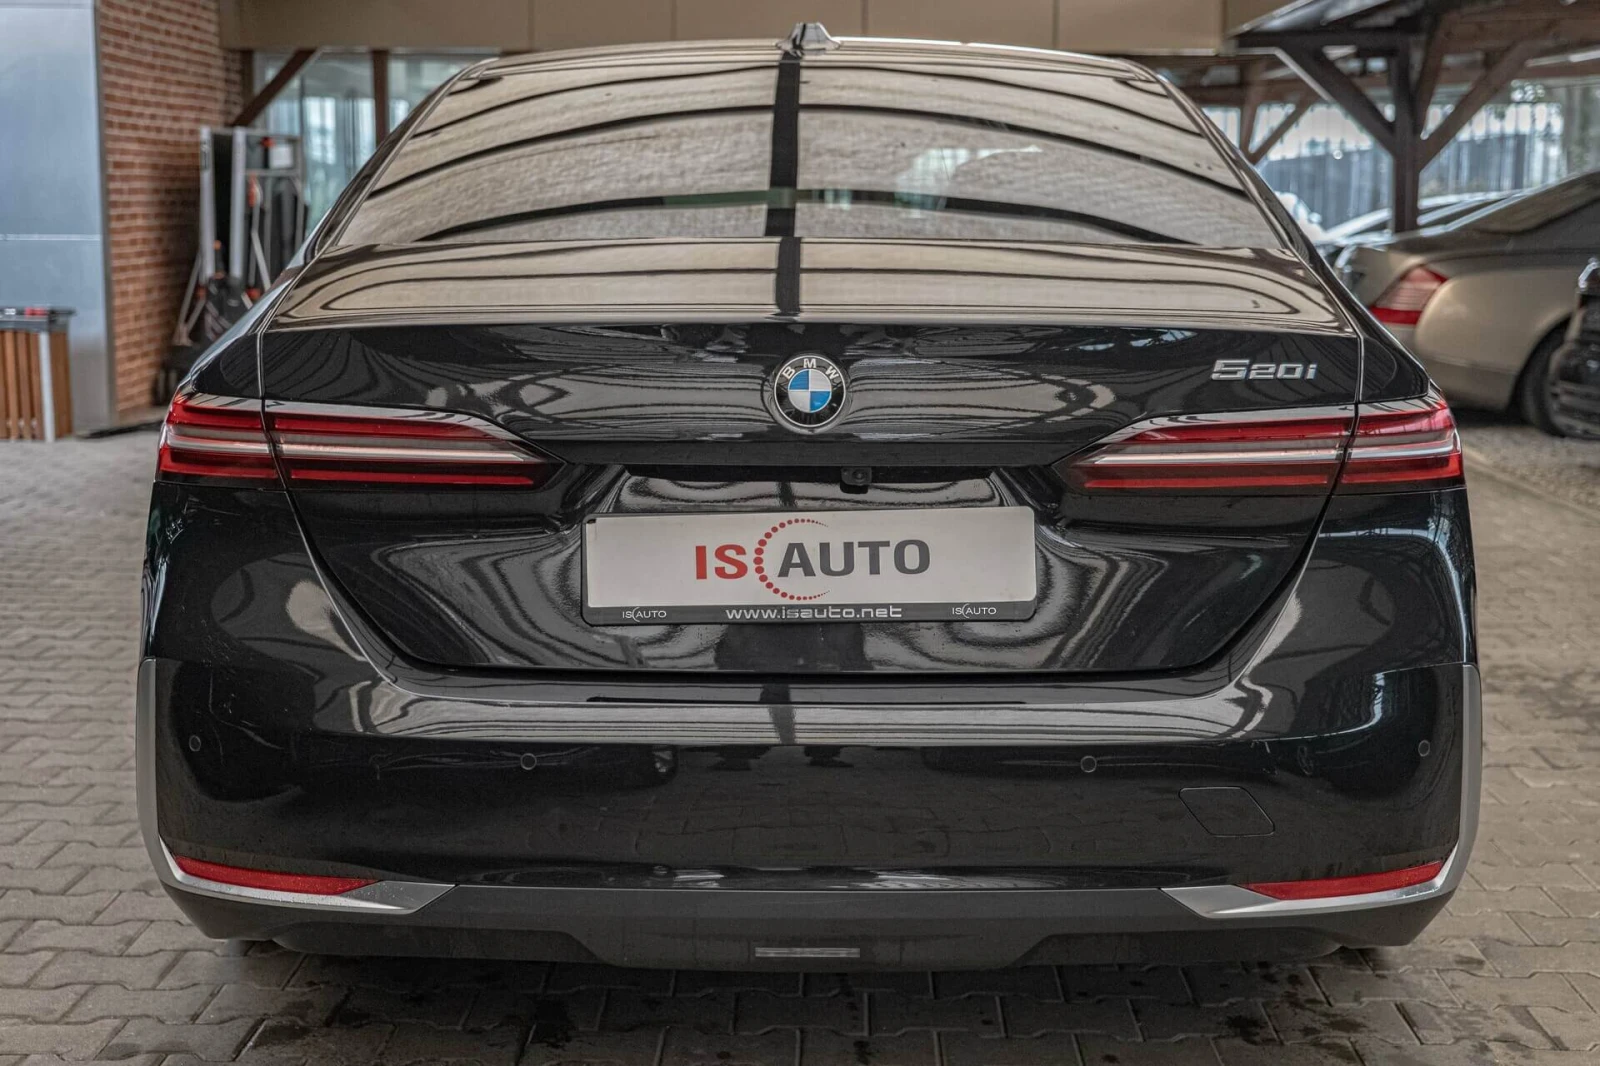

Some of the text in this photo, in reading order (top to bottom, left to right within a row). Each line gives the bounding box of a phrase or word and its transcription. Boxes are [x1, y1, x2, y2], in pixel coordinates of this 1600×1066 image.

[782, 358, 839, 380] BMW
[1211, 359, 1317, 381] 520i
[778, 539, 930, 577] AUTO
[725, 605, 902, 620] www.isauto.net
